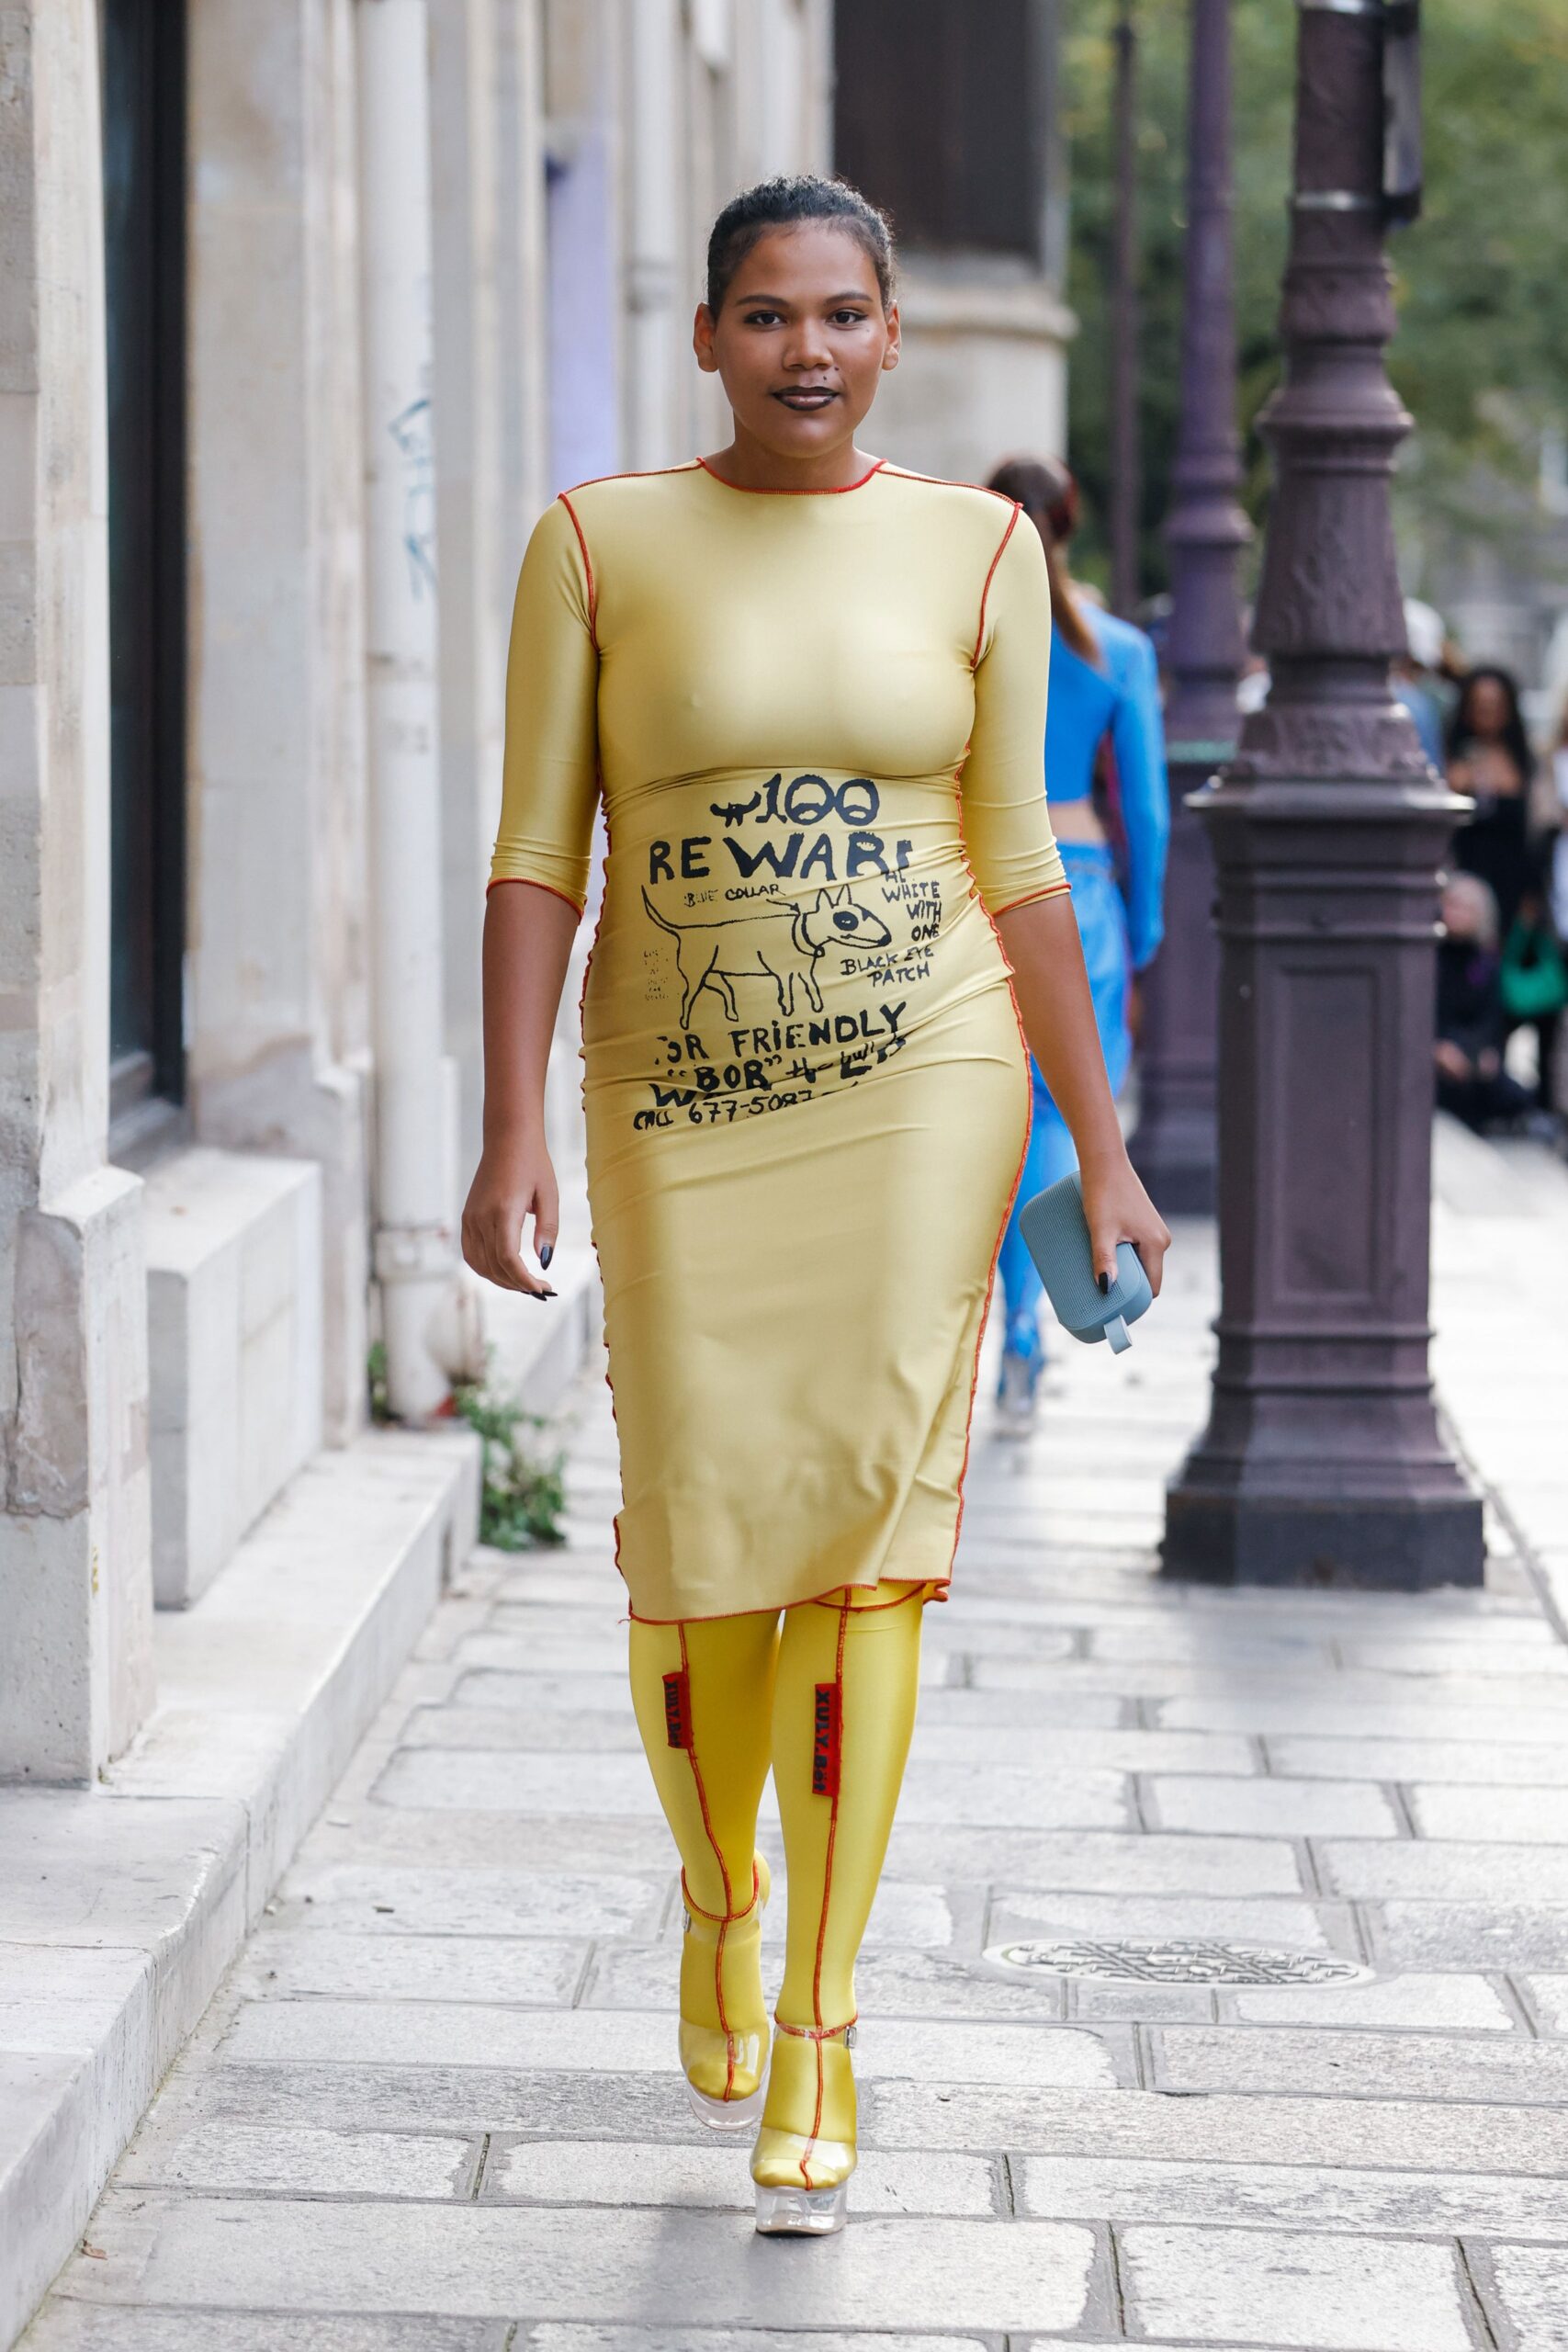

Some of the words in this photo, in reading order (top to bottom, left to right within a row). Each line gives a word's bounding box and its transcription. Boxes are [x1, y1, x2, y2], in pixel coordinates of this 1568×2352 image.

[725, 883, 786, 901] COLLAR
[881, 881, 942, 903] WHITE
[906, 899, 942, 923] WITH
[911, 922, 941, 942] ONE
[840, 952, 899, 976] BLACK
[867, 961, 931, 988] PATCH
[727, 1001, 907, 1057] FRIENDLY
